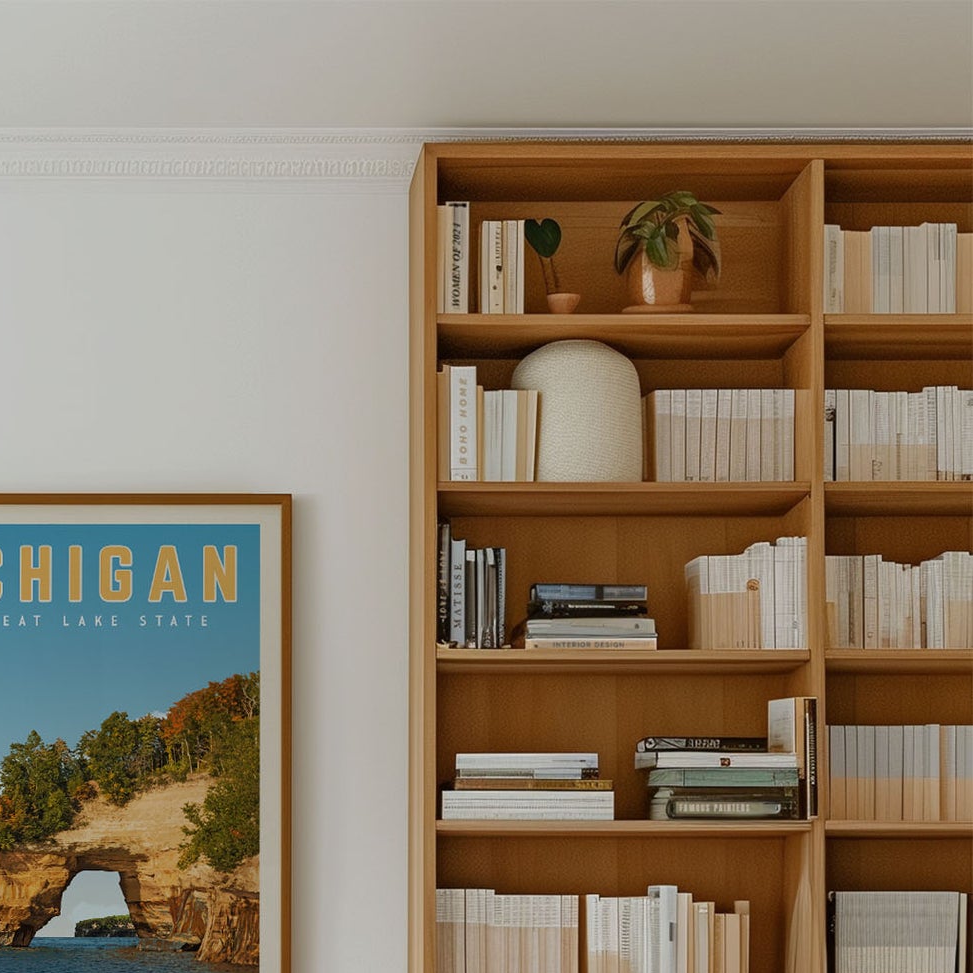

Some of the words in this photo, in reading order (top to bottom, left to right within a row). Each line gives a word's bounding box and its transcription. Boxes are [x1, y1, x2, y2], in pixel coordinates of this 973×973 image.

[451, 247, 461, 262] OF
[451, 263, 461, 307] WOMEN
[459, 376, 468, 418] HOME
[459, 425, 468, 465] BOHO
[453, 562, 463, 629] MATISSE
[63, 614, 119, 627] LAKE
[139, 614, 209, 627] STATE
[678, 803, 710, 813] FAMOUS
